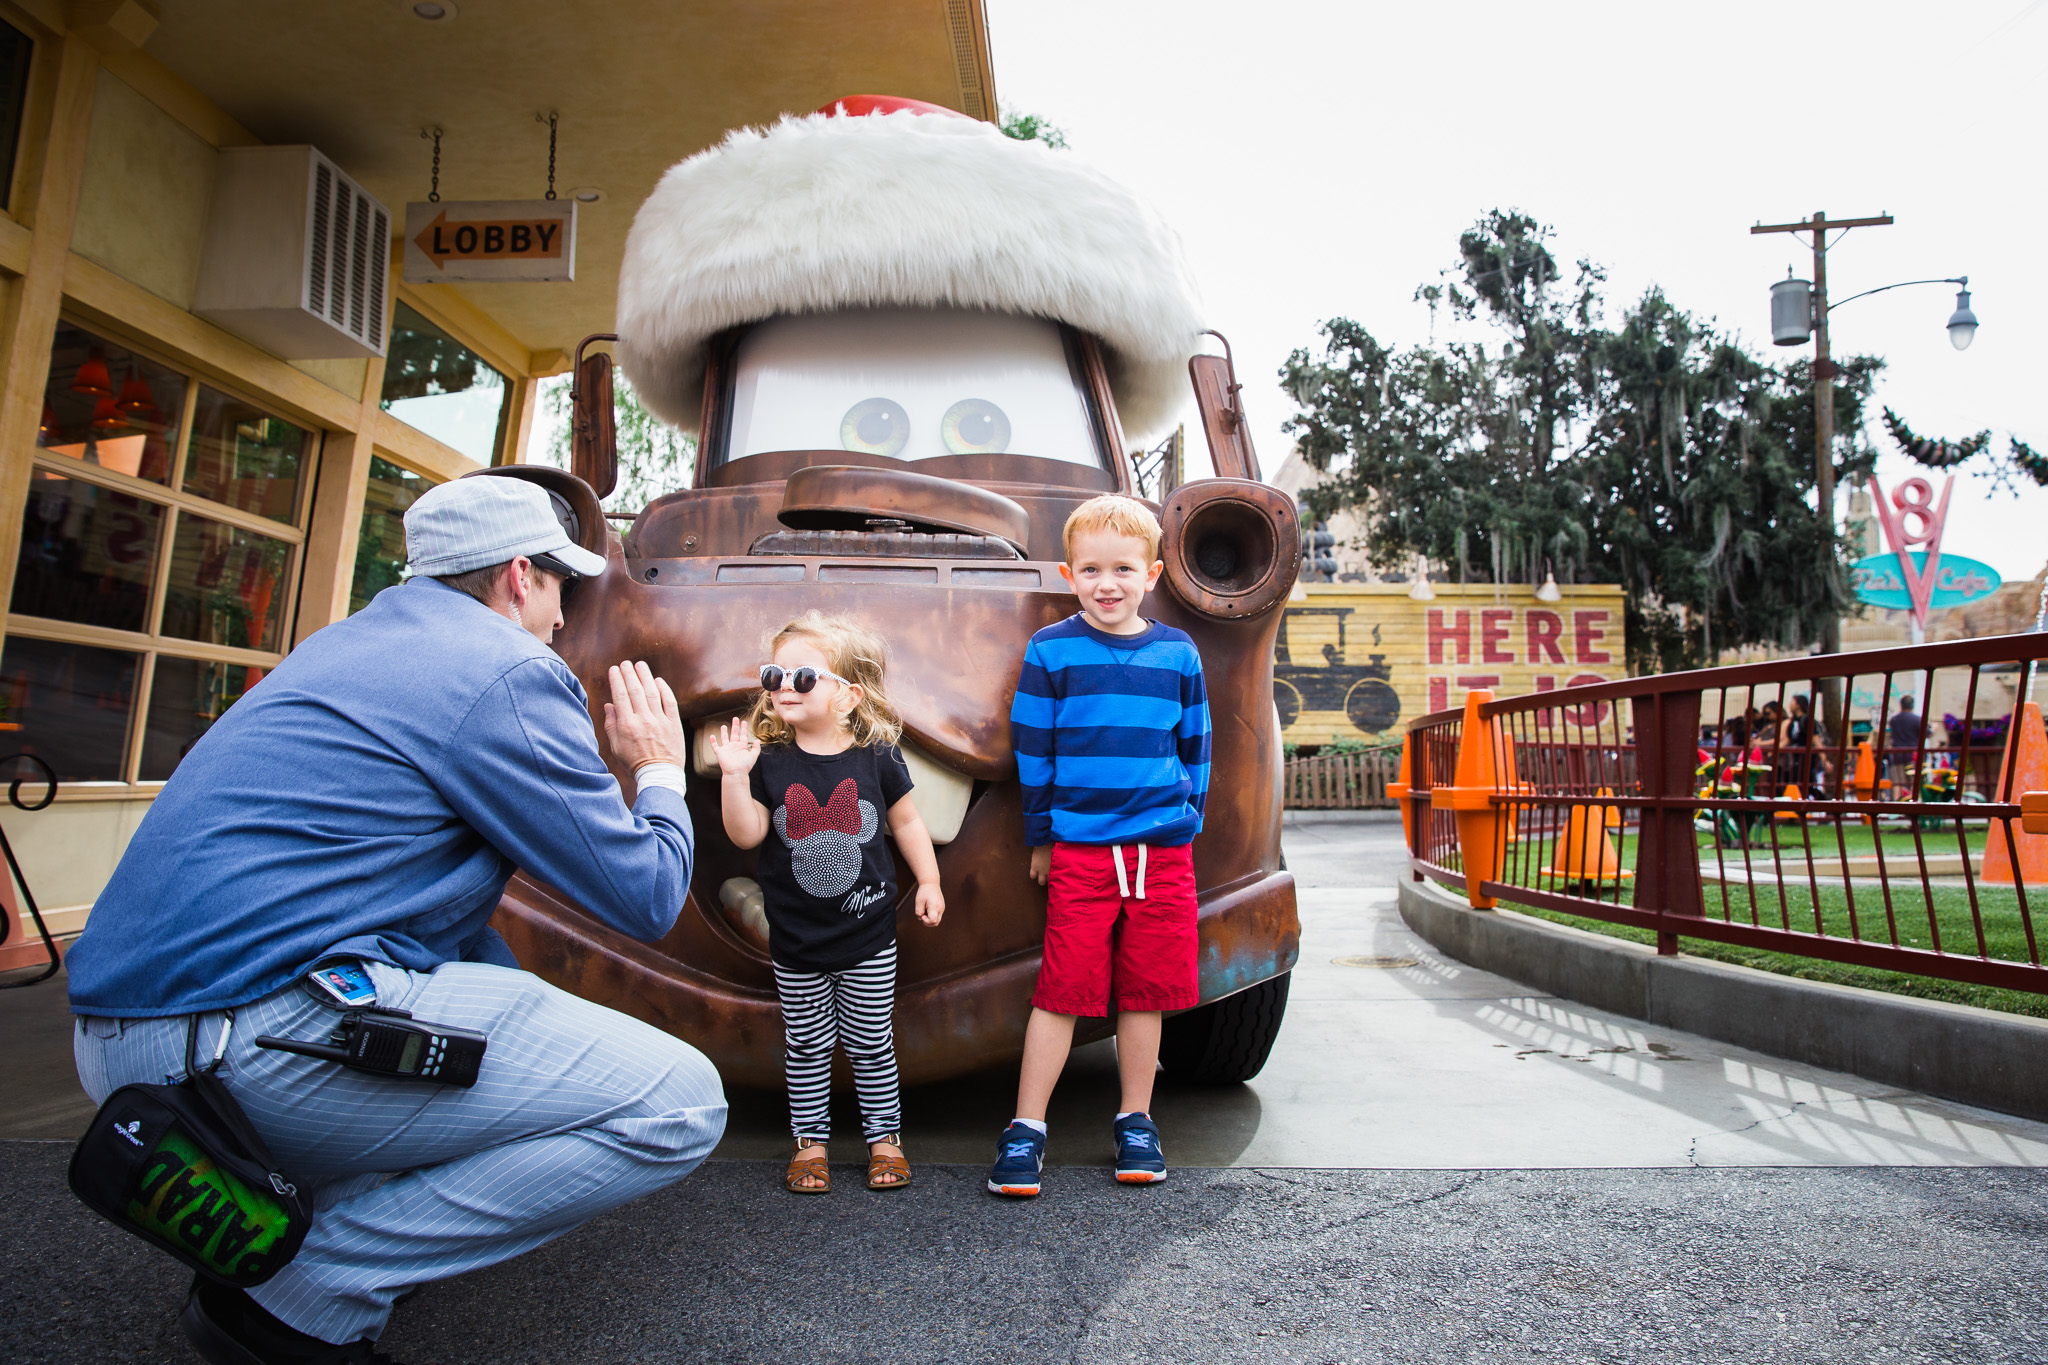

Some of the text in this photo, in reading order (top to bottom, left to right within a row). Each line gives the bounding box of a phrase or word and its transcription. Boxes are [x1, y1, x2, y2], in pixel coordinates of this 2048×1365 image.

[433, 224, 558, 254] LOBBY
[1935, 567, 1993, 597] Cafe
[1427, 608, 1611, 666] HERE
[841, 881, 887, 919] Minnie
[358, 1031, 370, 1057] KENWOOD
